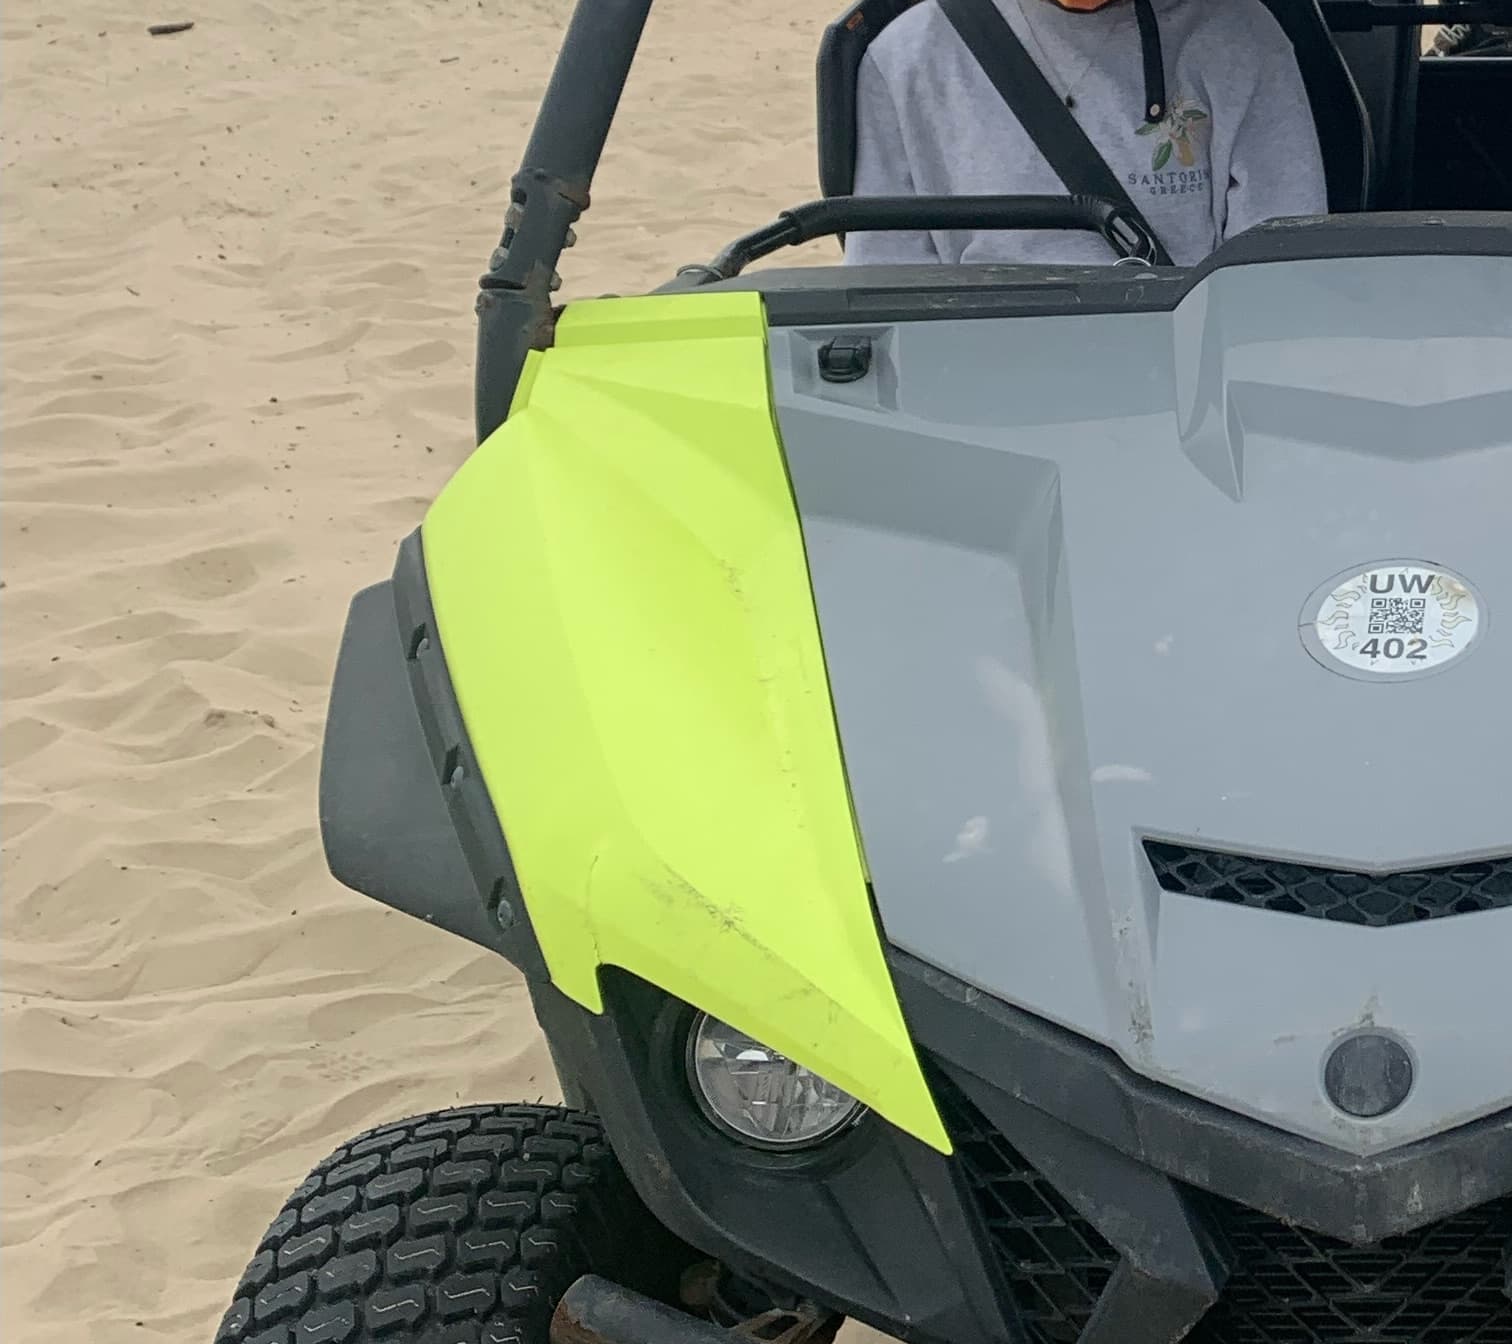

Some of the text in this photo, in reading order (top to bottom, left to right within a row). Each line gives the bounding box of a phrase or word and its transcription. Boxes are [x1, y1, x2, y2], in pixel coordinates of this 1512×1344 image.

[1149, 182, 1204, 196] GREECE
[1369, 573, 1436, 594] UW
[1359, 637, 1428, 660] 402
